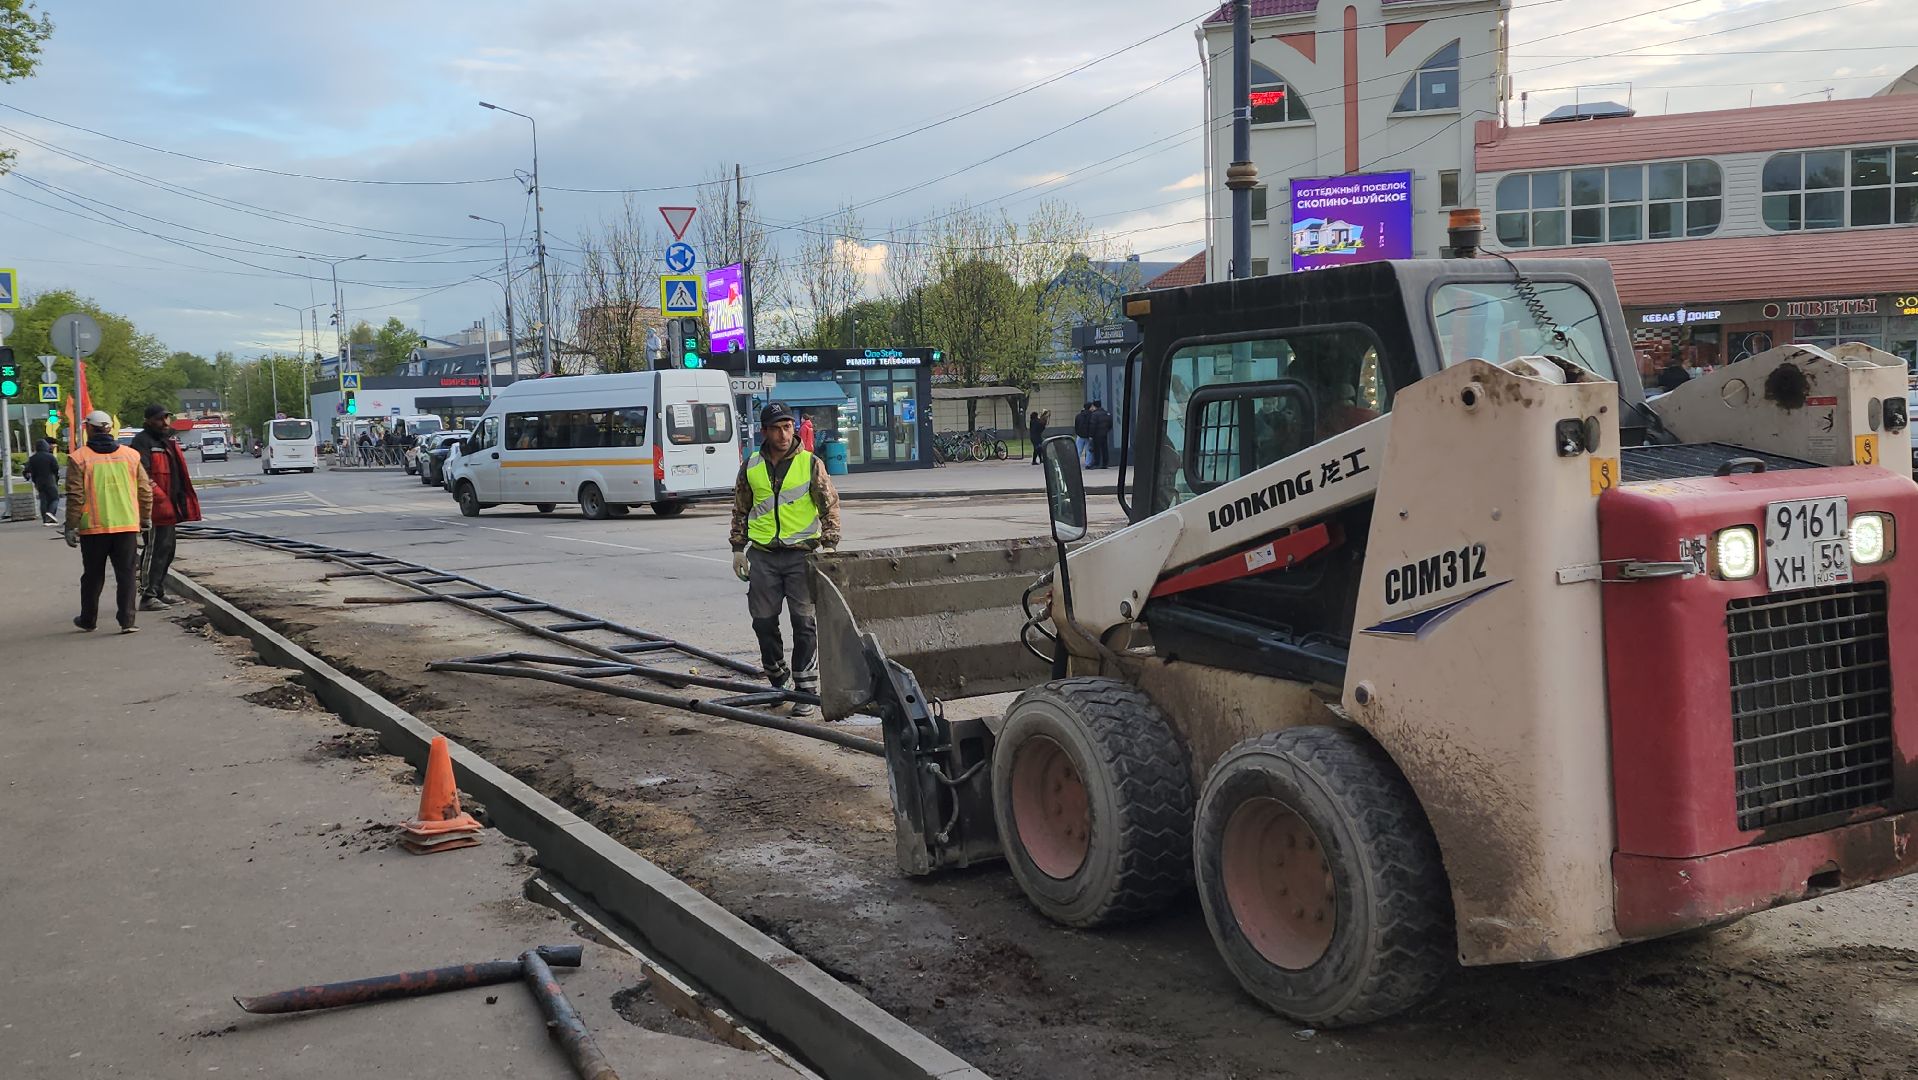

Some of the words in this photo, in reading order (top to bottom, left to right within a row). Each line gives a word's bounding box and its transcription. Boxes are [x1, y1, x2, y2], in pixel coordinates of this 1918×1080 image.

[1297, 185, 1360, 197] КОТТЕДЖНЫЙ
[1362, 182, 1407, 192] ПОСЕЛОК
[1297, 193, 1407, 208] СКОПИНО-ШУЙСКОЕ
[1642, 313, 1676, 323] КЕБАБ
[1686, 310, 1721, 321] ДОНЕР
[1787, 299, 1878, 319] ЦВЕТЫ
[846, 358, 876, 366] РЕМОНТ
[878, 357, 921, 366] ТЕЛЕФОНОВ
[1208, 469, 1314, 533] LONKING
[1319, 447, 1371, 489] 龙工
[1777, 502, 1838, 541] 9161
[1821, 543, 1844, 570] 50
[1385, 542, 1487, 605] CDM312
[1817, 573, 1835, 583] RUS
